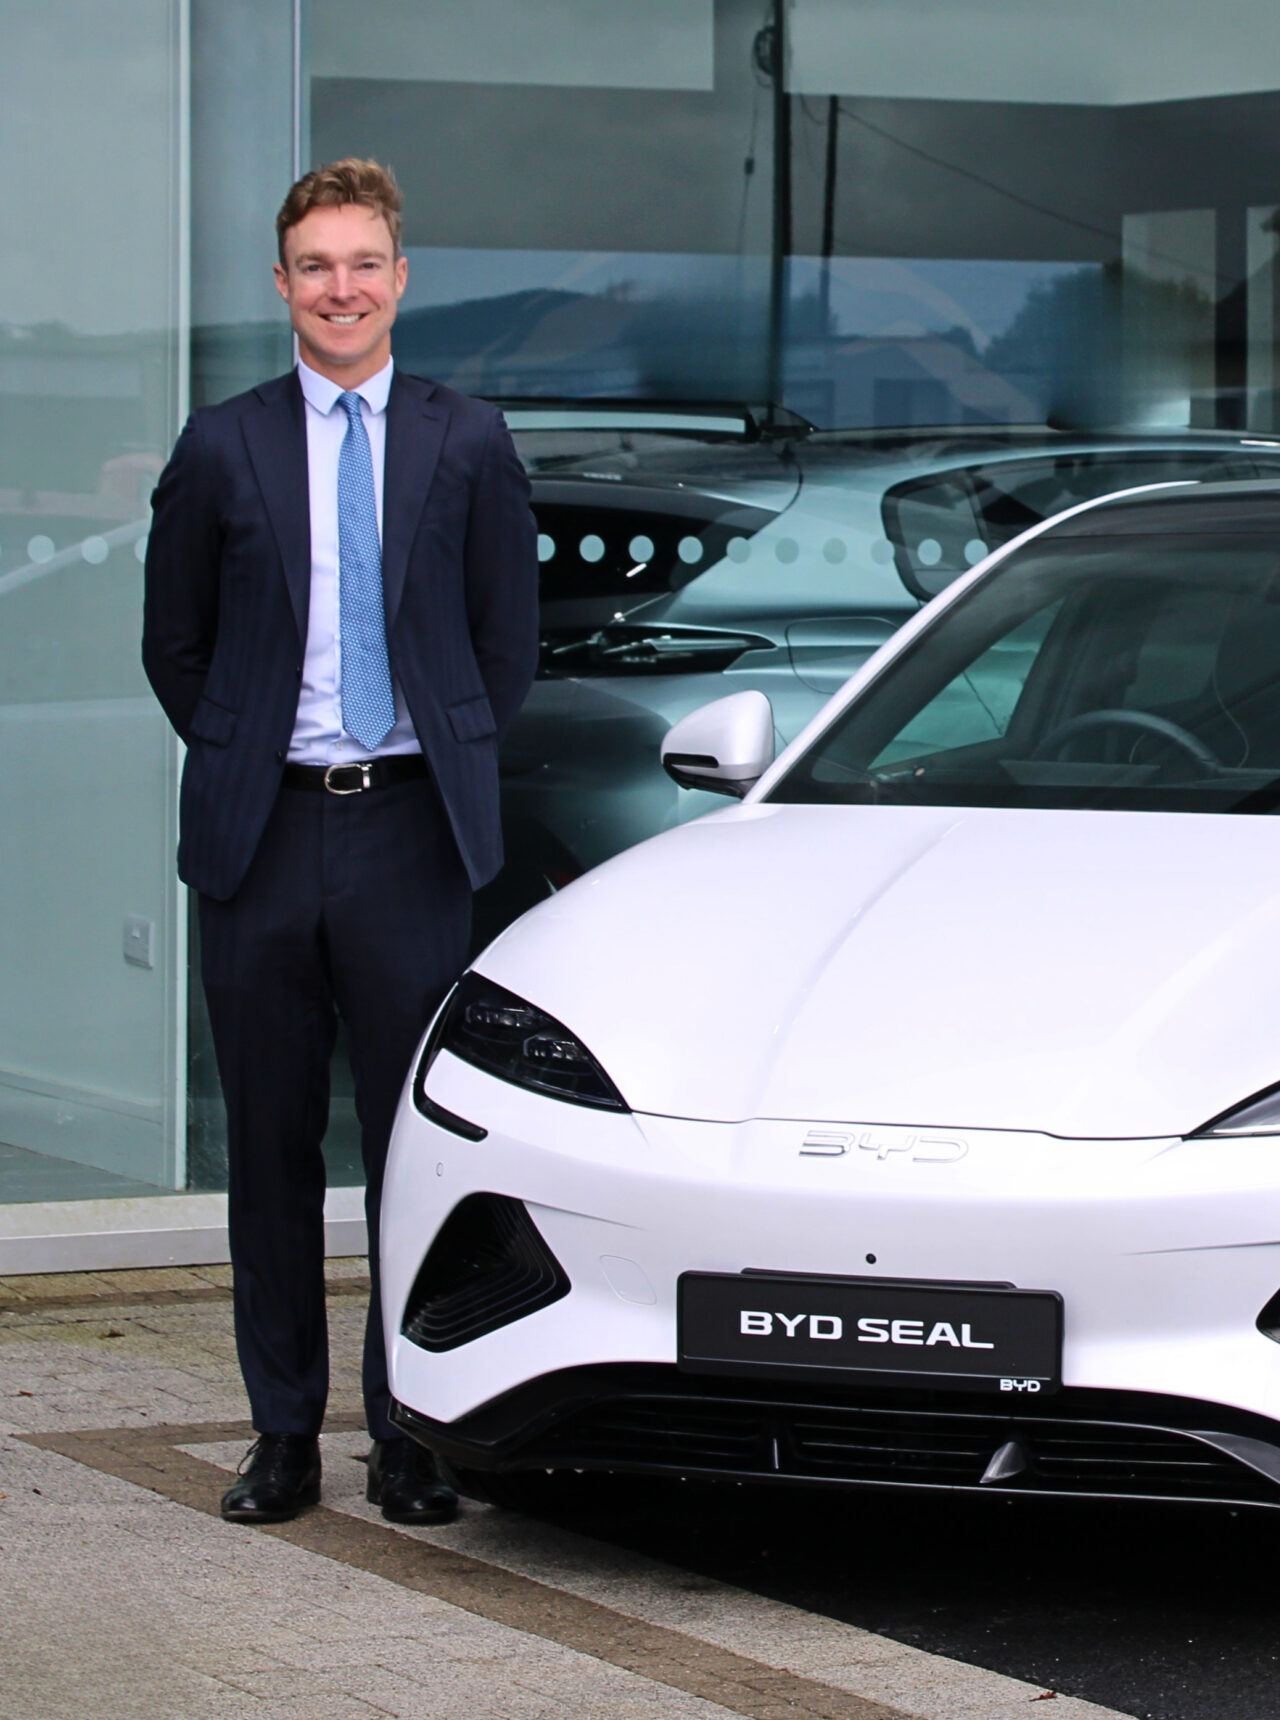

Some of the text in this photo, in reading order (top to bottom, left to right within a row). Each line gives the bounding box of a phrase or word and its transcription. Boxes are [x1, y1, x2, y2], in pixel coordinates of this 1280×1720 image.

[799, 1129, 970, 1163] BYD
[740, 1311, 995, 1349] BYD SEAL
[1000, 1378, 1040, 1393] BYD
